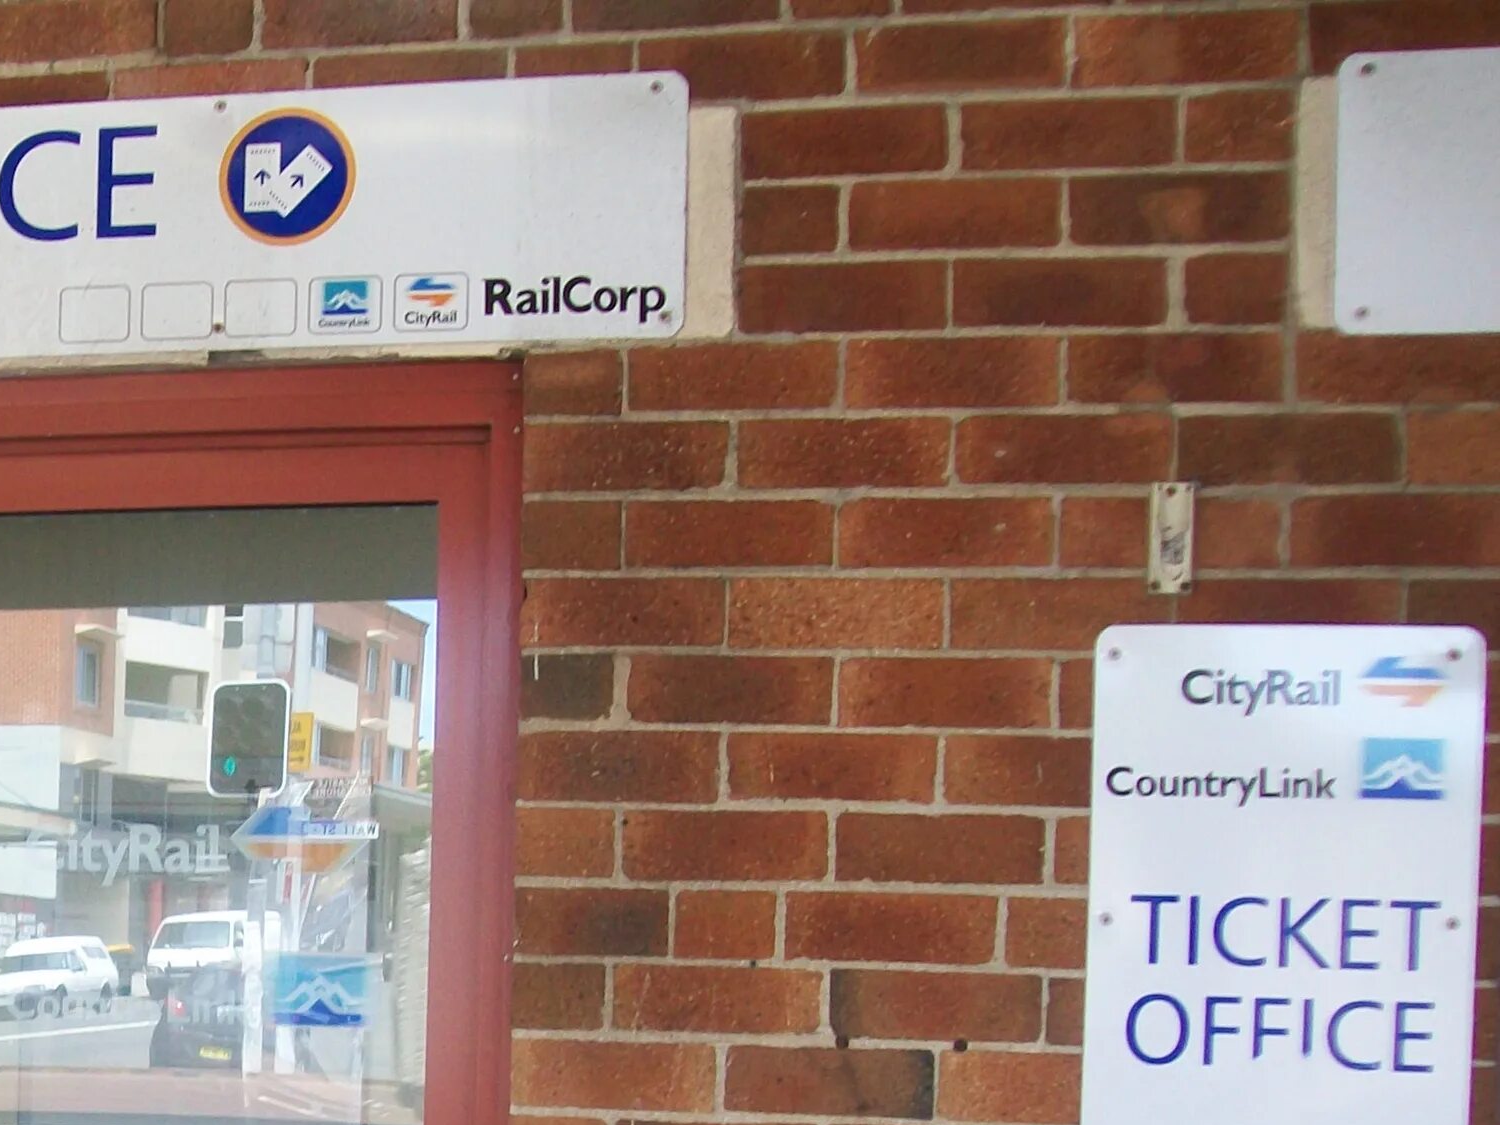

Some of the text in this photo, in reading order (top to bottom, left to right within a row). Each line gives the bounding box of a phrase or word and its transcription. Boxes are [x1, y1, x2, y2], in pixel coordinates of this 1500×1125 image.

[404, 310, 458, 328] CityRail
[483, 276, 667, 324] RailCorp
[1180, 669, 1342, 716] CityRail
[1106, 766, 1336, 807] CountryLink
[1131, 895, 1442, 972] TICKET
[1126, 993, 1436, 1073] OFFICE
